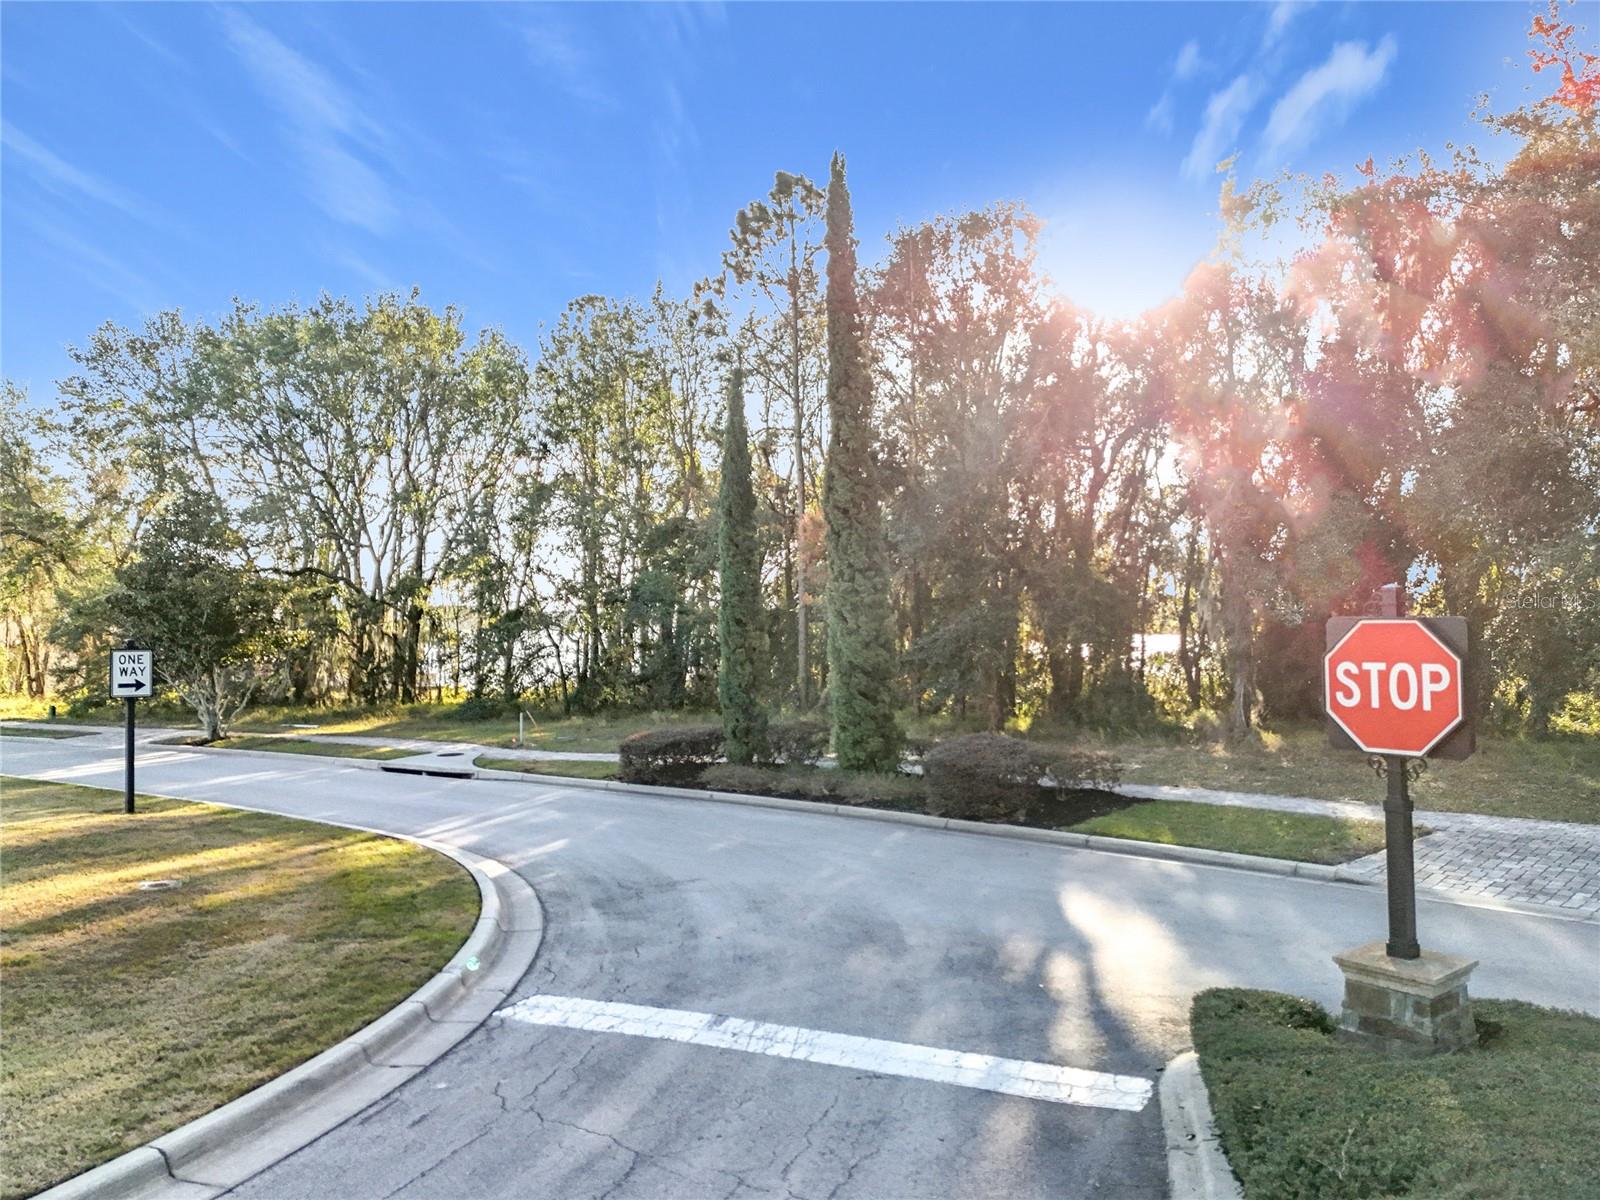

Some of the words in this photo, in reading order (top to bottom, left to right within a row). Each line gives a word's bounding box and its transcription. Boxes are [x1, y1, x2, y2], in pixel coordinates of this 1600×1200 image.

[118, 654, 144, 665] ONE
[119, 666, 146, 677] WAY
[1335, 661, 1451, 711] STOP
